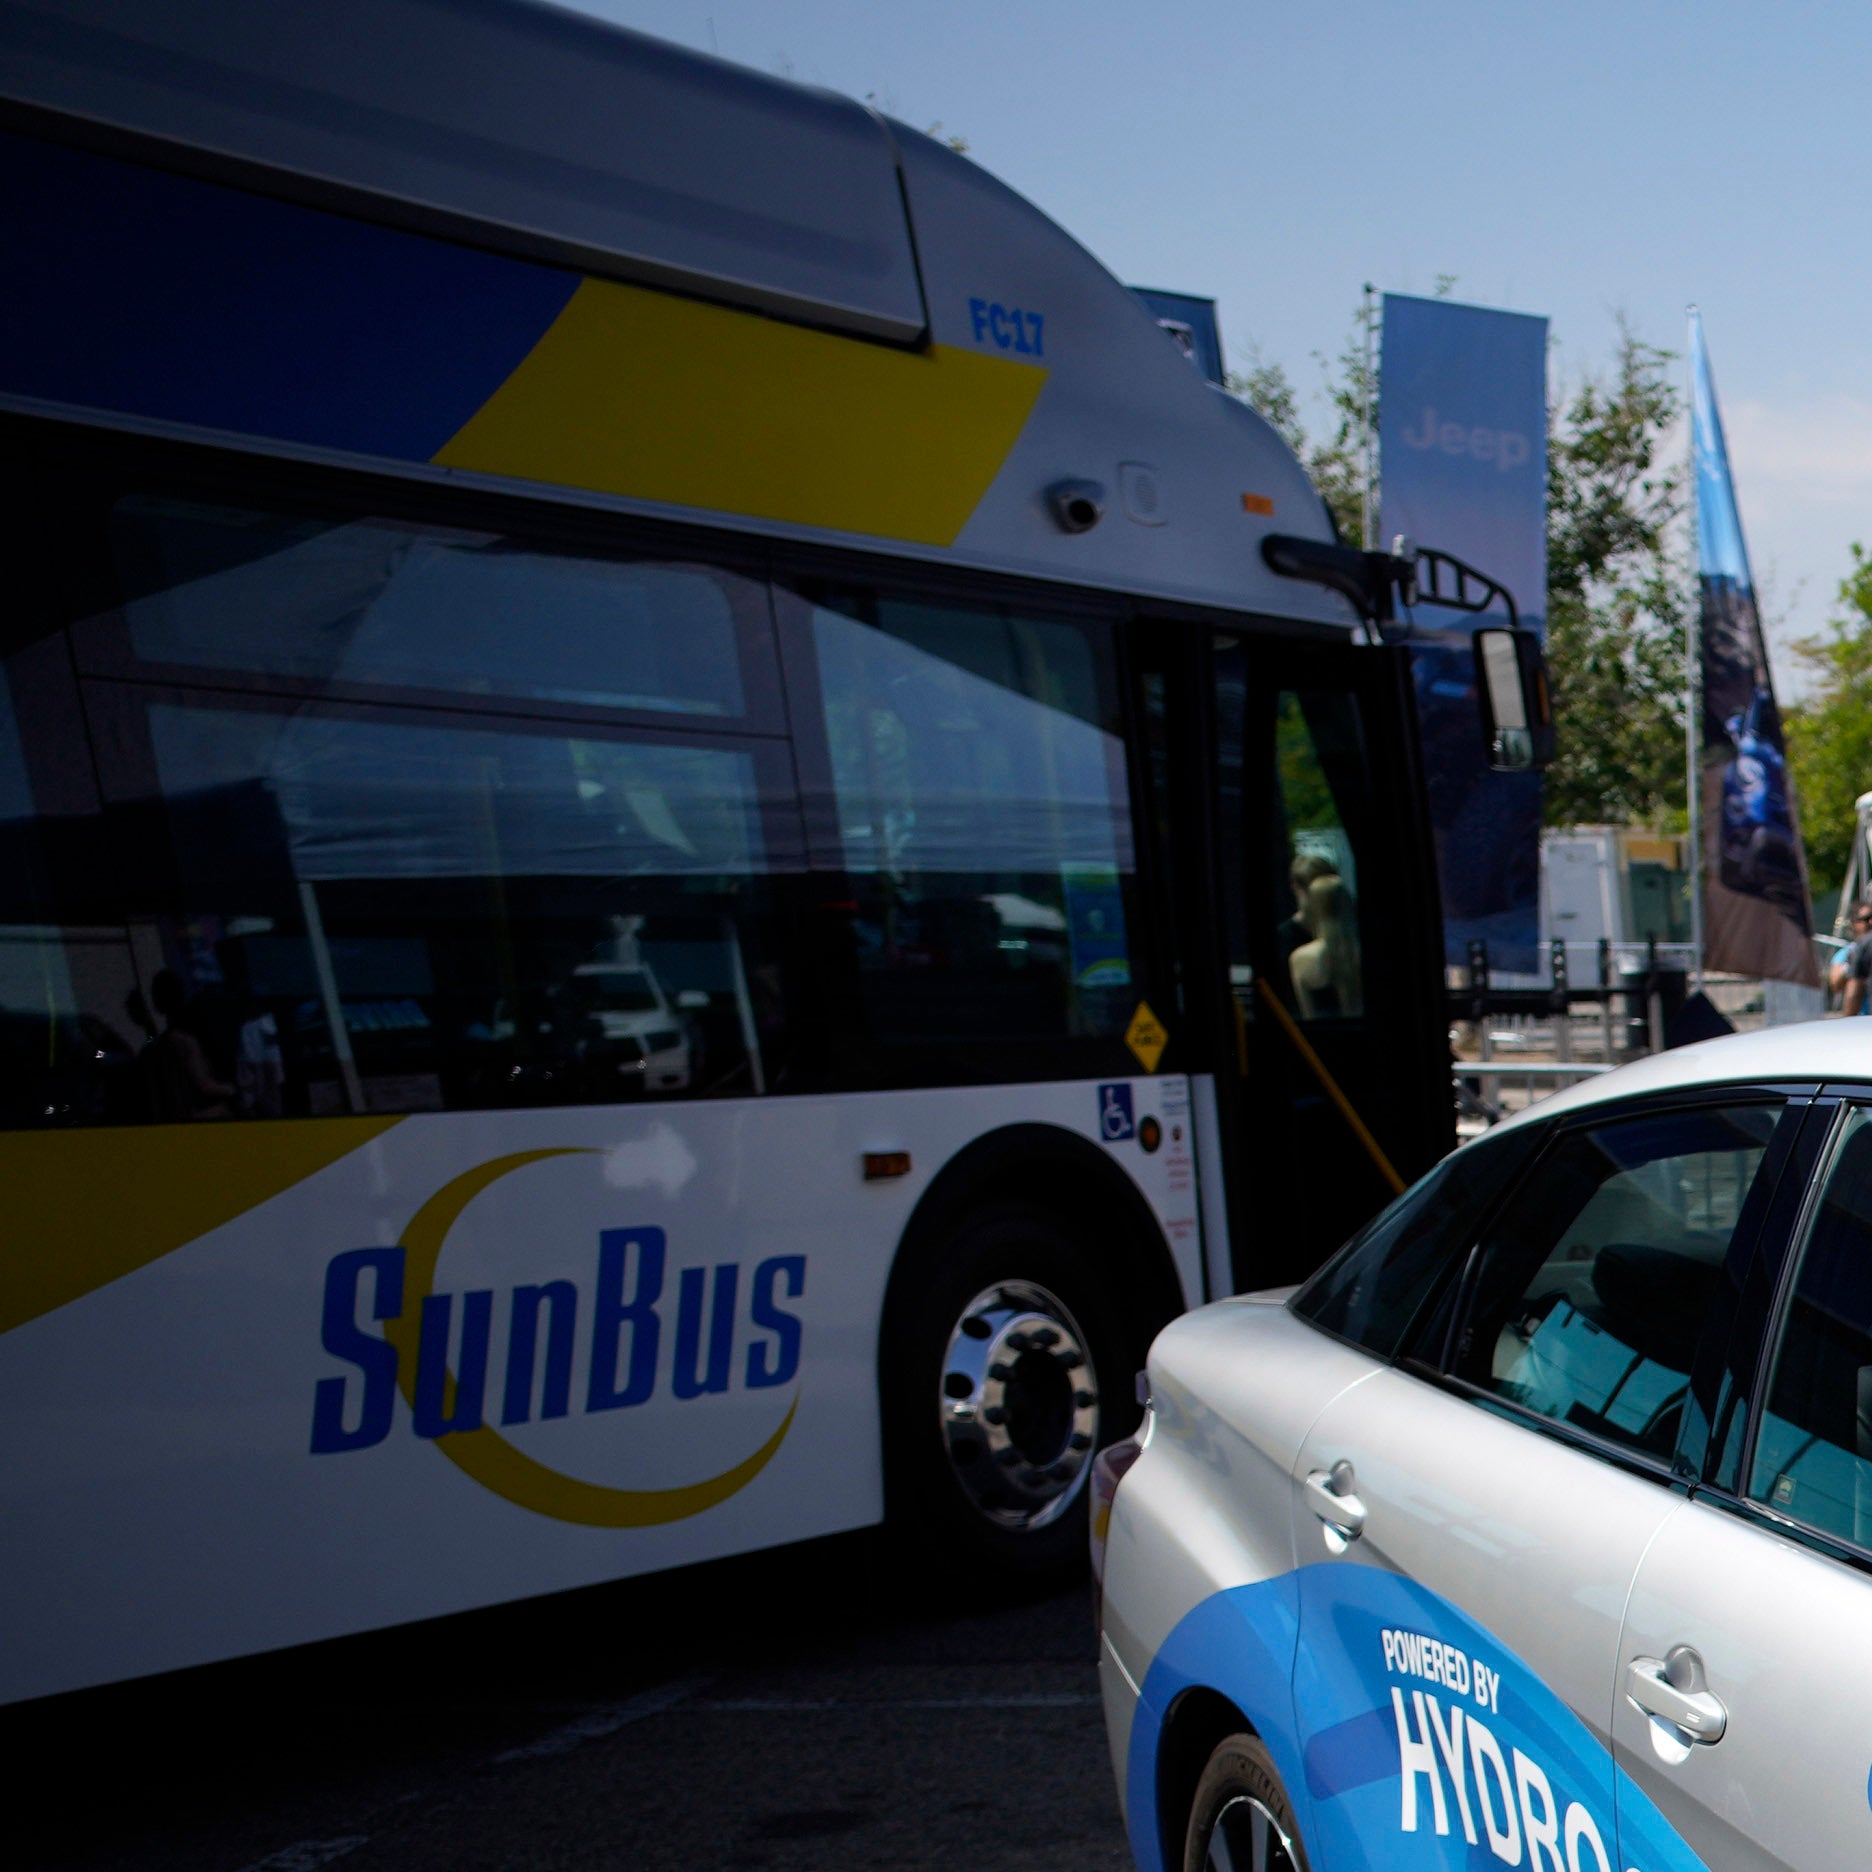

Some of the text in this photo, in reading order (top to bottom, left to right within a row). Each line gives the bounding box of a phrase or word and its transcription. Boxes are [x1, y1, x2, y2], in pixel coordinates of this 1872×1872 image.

[968, 296, 1046, 358] FC17
[1399, 406, 1532, 473] Jeep
[309, 1225, 807, 1455] SunBus
[1382, 1629, 1499, 1714] POWERED BY
